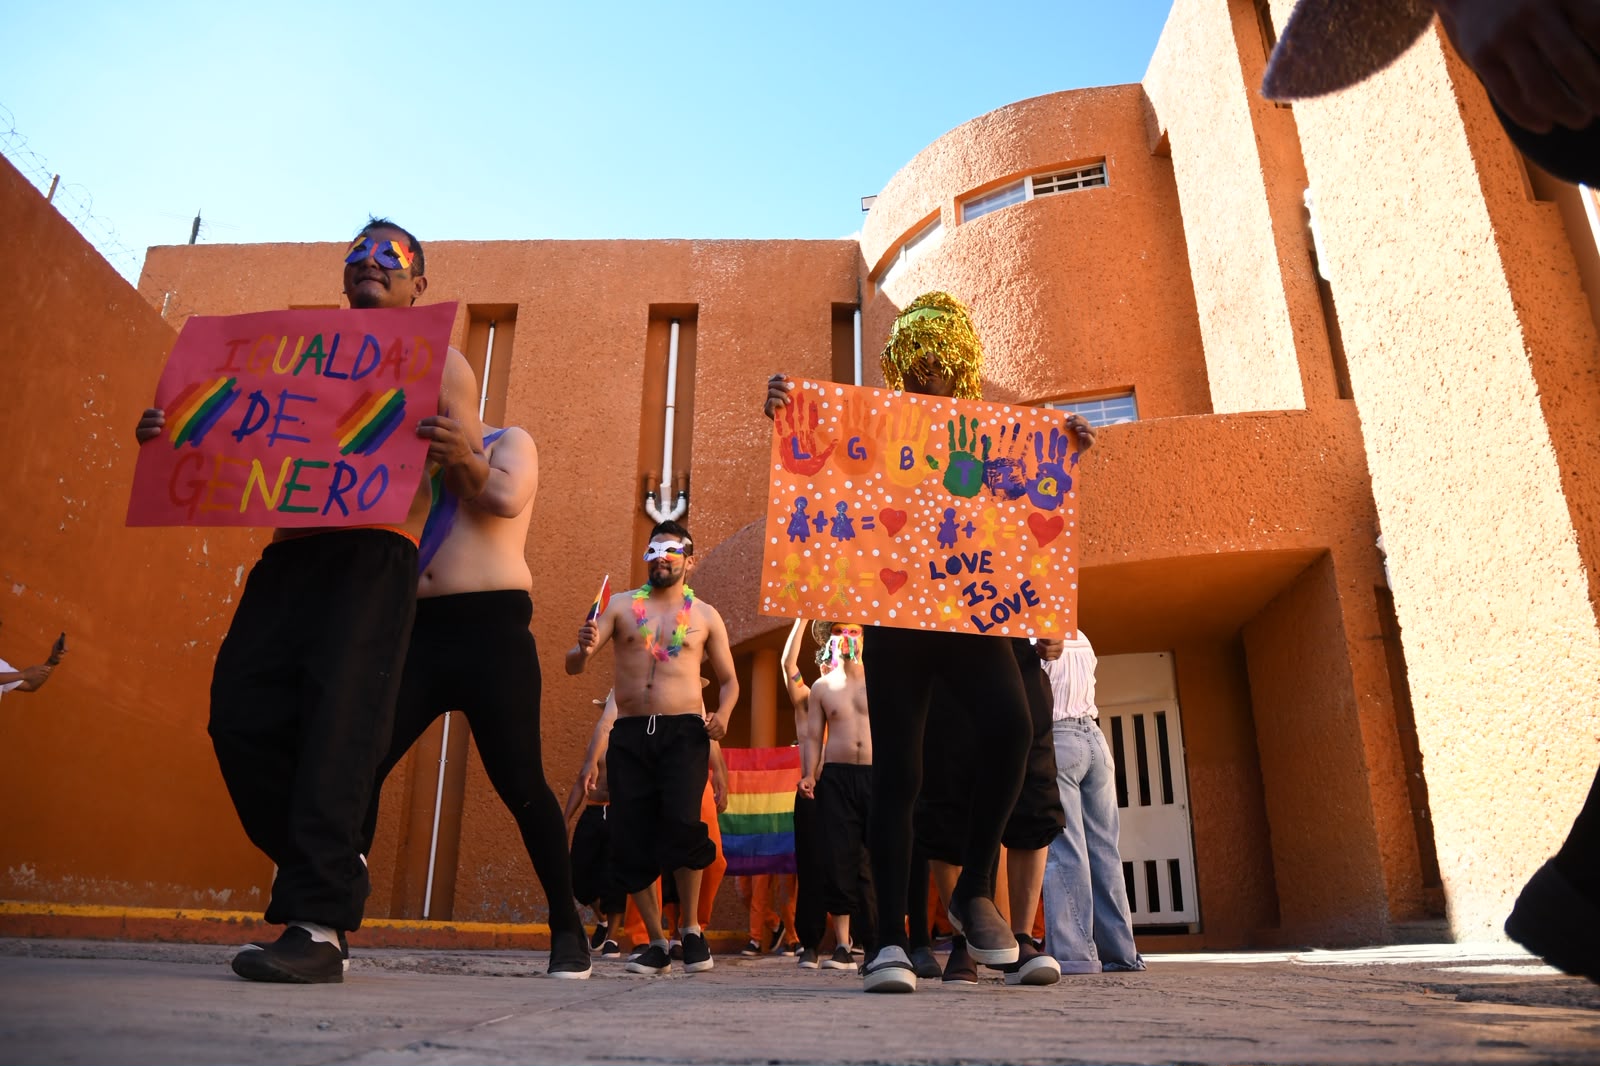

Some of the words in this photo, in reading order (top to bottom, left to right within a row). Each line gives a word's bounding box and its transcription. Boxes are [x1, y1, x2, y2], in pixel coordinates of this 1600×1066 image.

[215, 333, 433, 385] IGUALDAD
[231, 389, 317, 447] DE
[168, 452, 389, 521] GENERO
[929, 550, 994, 580] LOVE
[962, 580, 998, 607] IS
[970, 580, 1040, 633] LOVE
